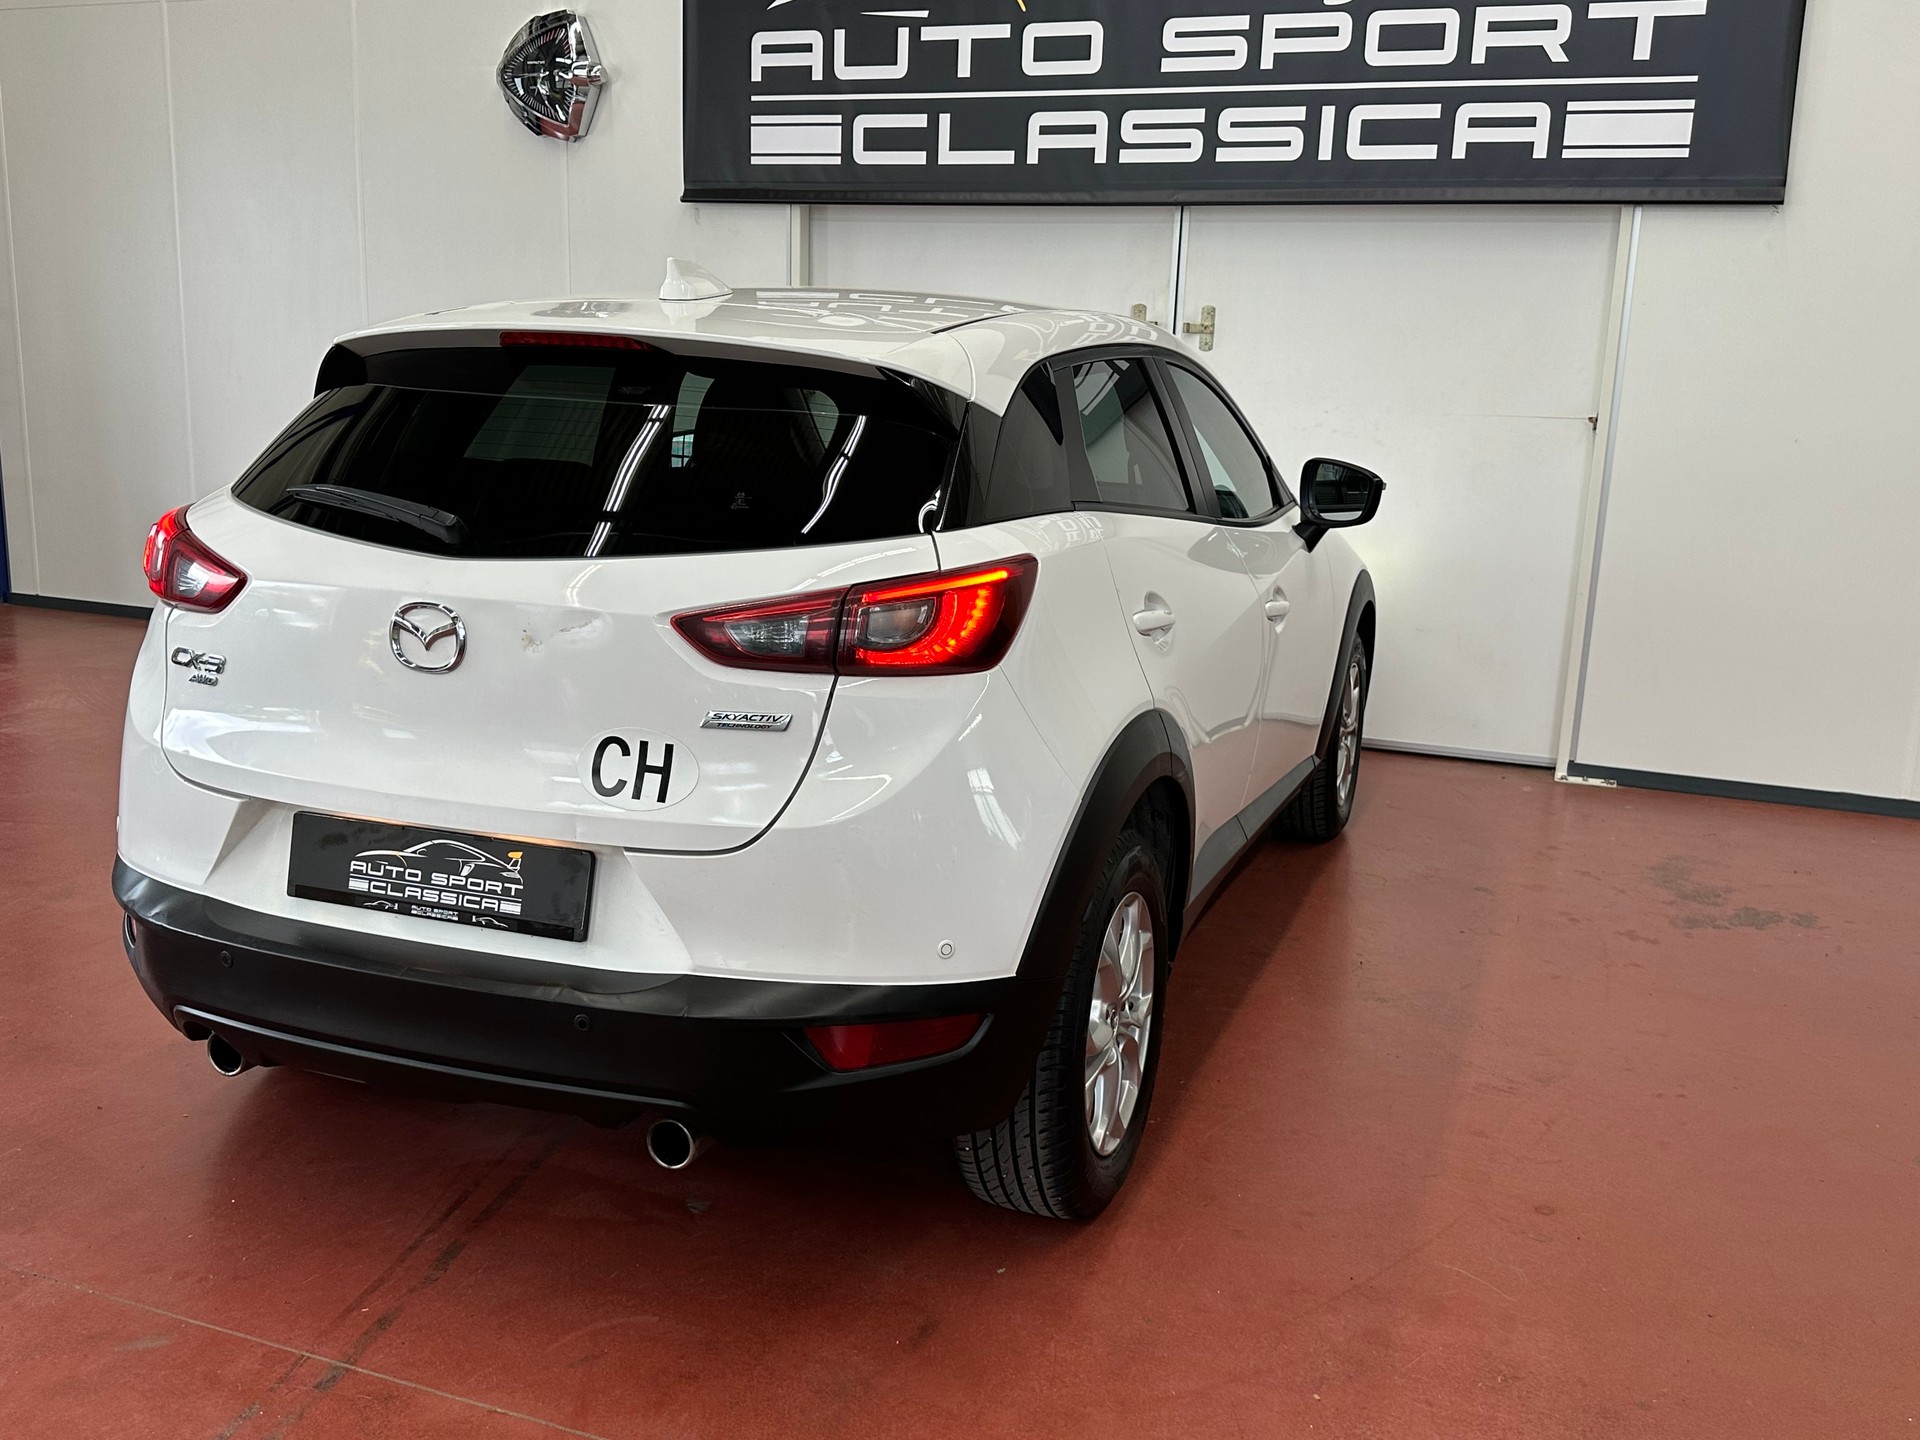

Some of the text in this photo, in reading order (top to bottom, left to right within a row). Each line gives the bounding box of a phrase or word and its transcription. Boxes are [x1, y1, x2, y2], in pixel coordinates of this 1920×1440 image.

[750, 0, 1708, 82] AUTO SPORT
[852, 101, 1552, 165] CLASSICA
[711, 712, 784, 722] SKYACTIV
[716, 722, 773, 730] TECHNOLOGY
[591, 735, 675, 804] CH
[350, 860, 524, 896] AUTO SPORT
[369, 880, 499, 912] CLASSICA
